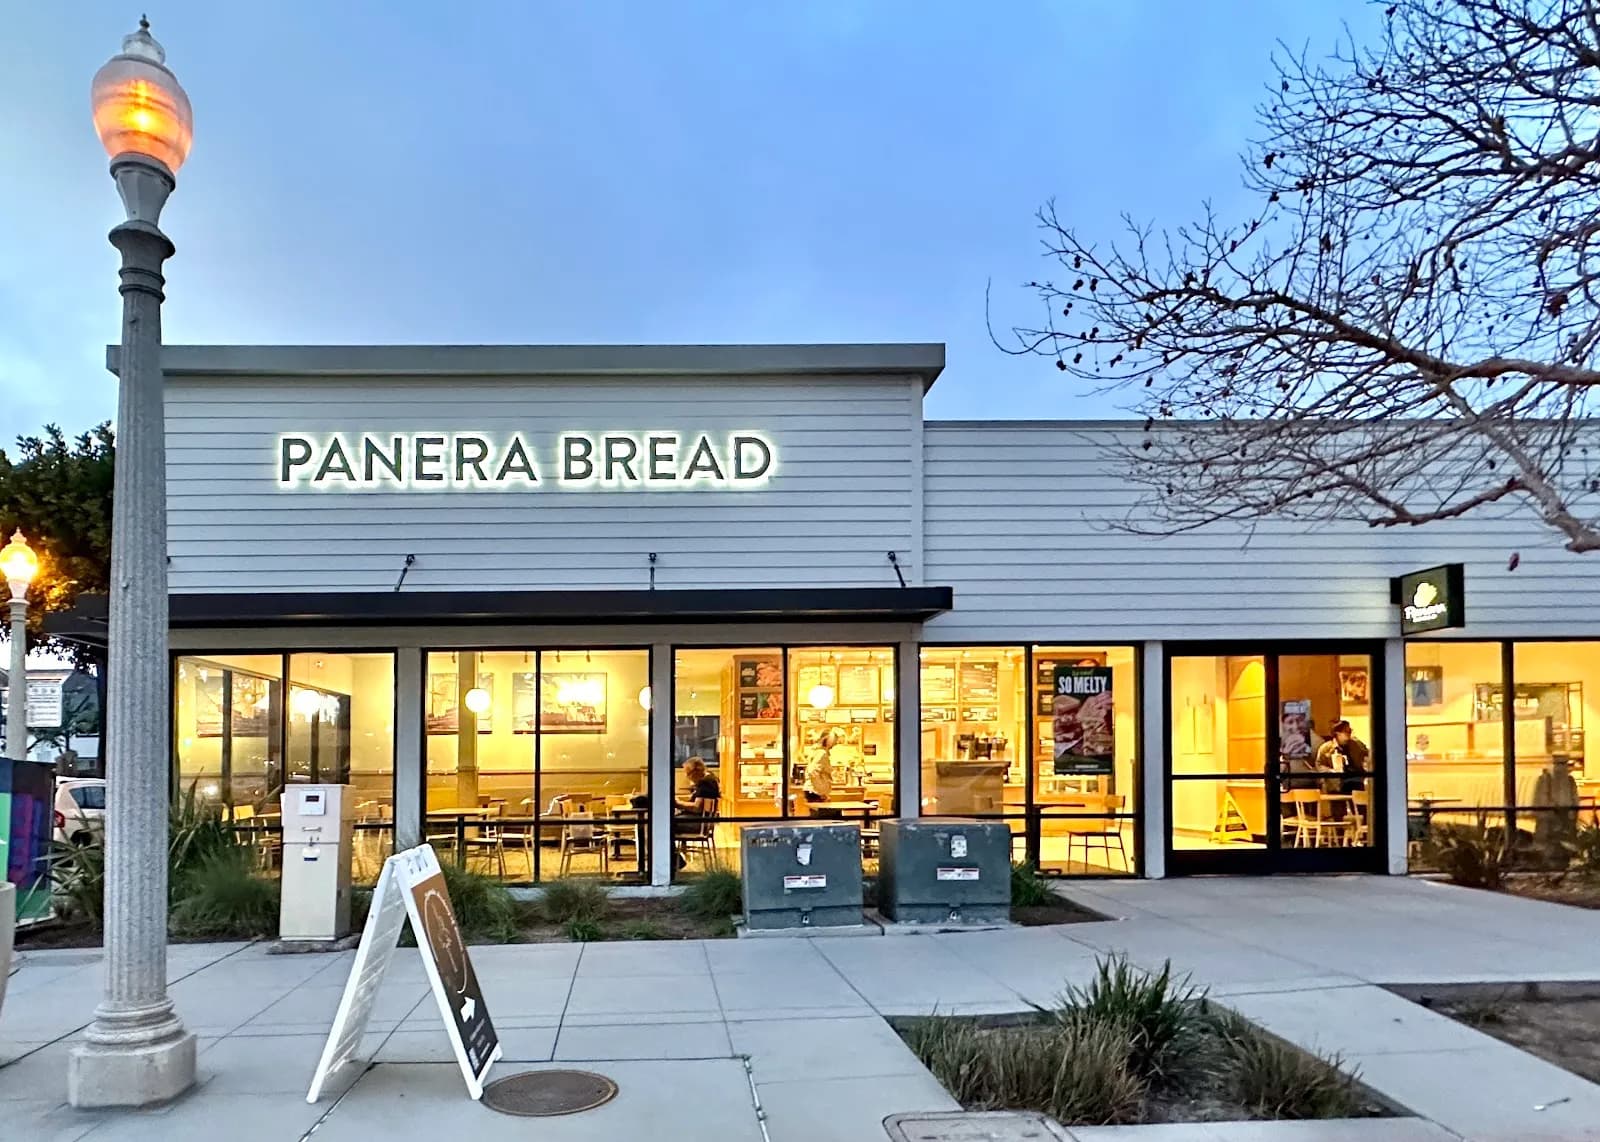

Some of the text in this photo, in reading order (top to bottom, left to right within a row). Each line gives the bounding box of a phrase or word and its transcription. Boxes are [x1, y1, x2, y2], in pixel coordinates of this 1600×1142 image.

[281, 435, 772, 481] PANERA BREAD
[1058, 676, 1107, 694] SO MELTY
